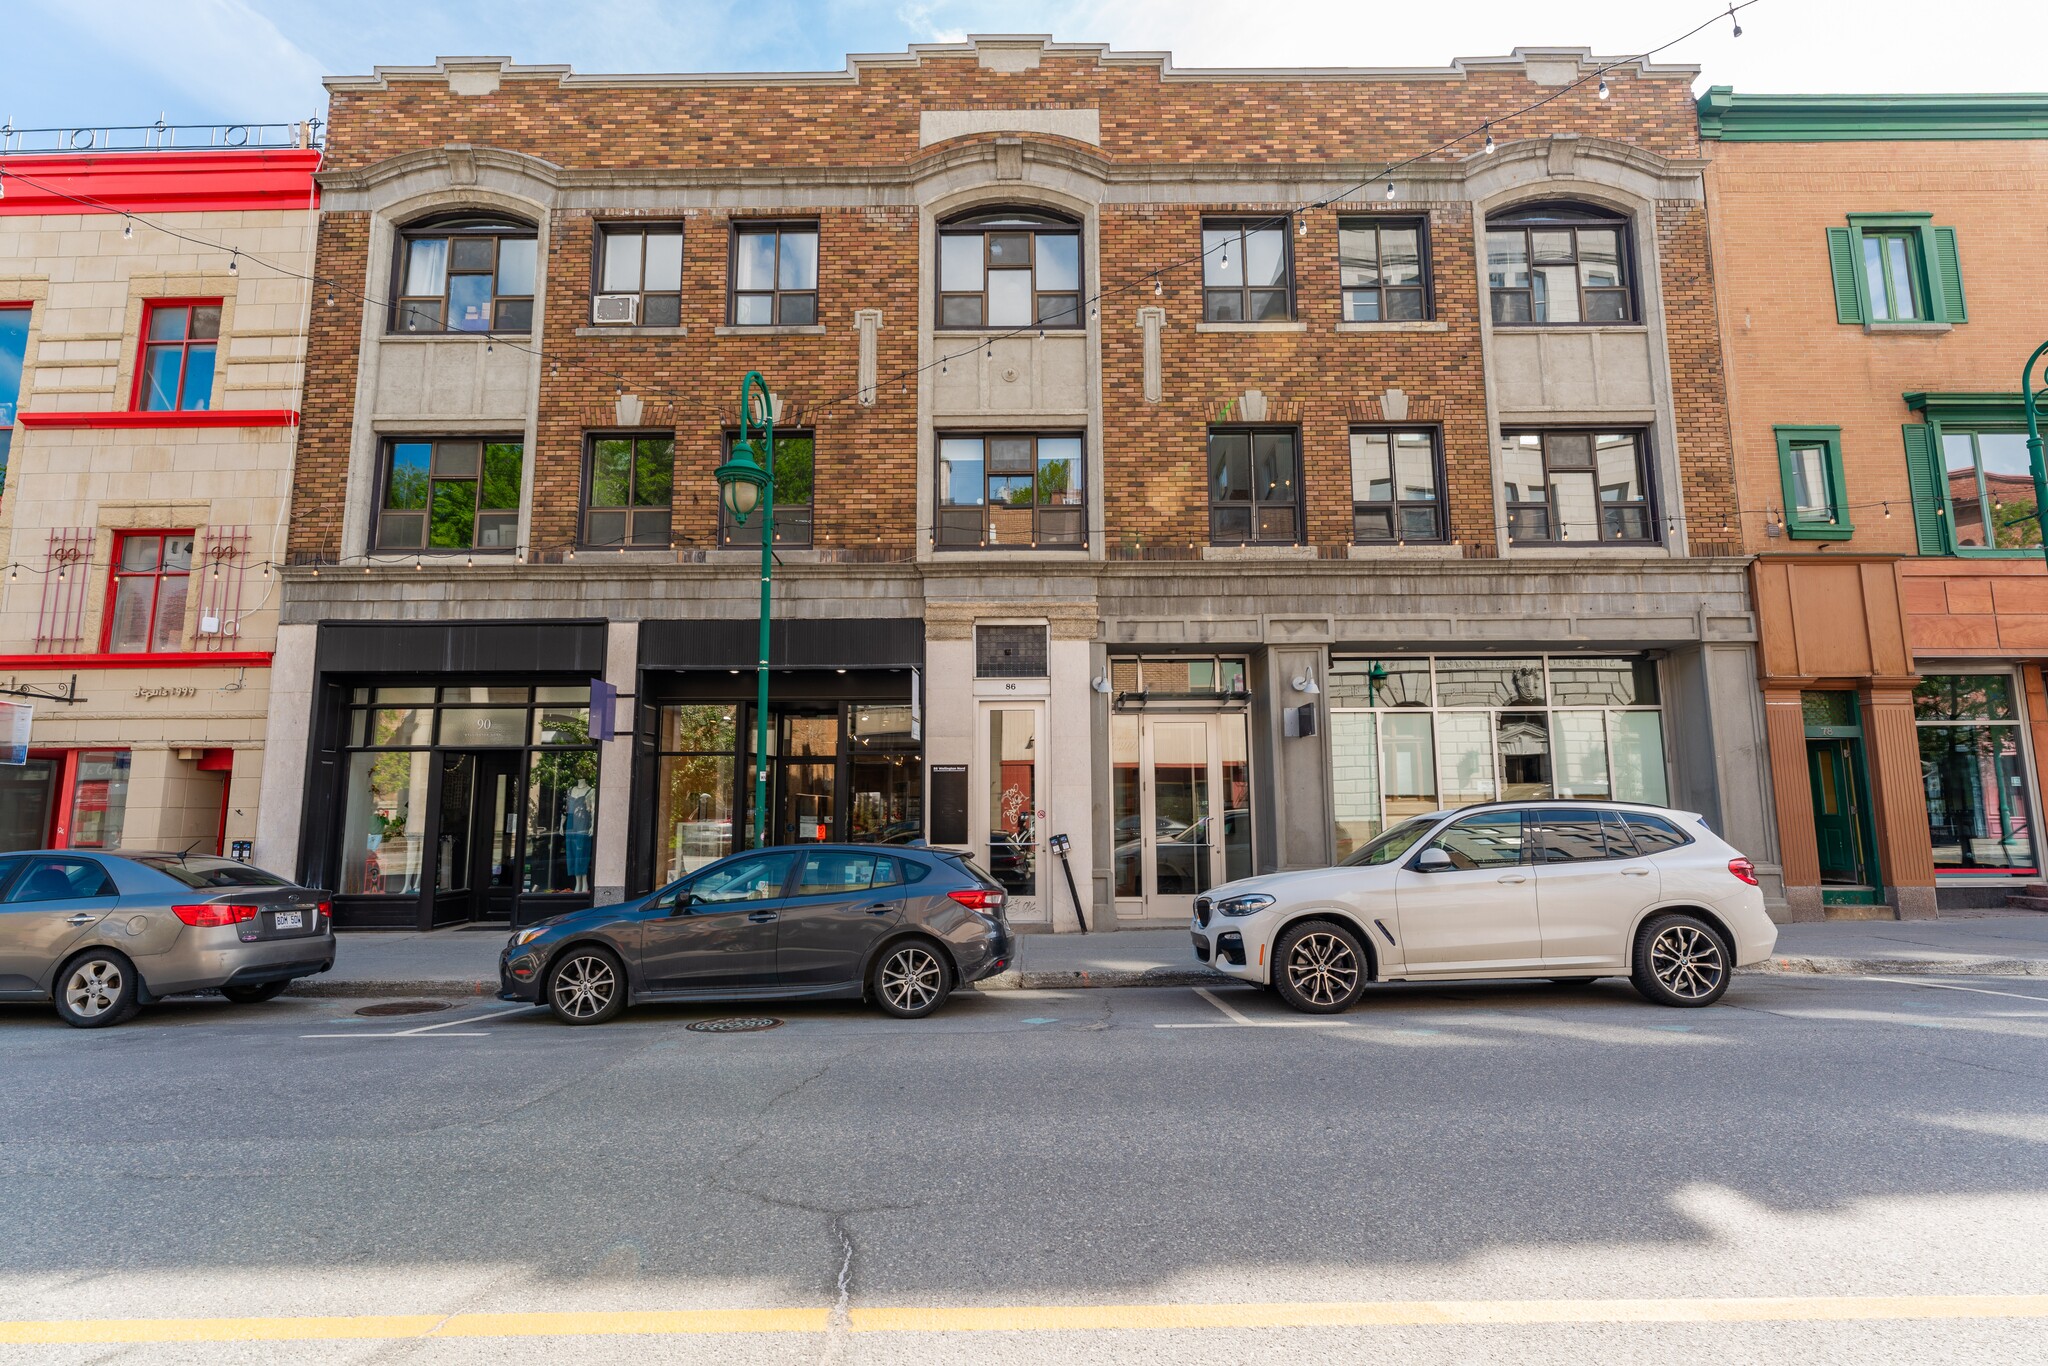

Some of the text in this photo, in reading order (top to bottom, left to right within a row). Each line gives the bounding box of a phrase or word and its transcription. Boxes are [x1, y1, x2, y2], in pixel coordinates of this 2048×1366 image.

[133, 686, 196, 702] depuis 1999
[477, 718, 491, 730] 90
[1820, 726, 1833, 736] 78
